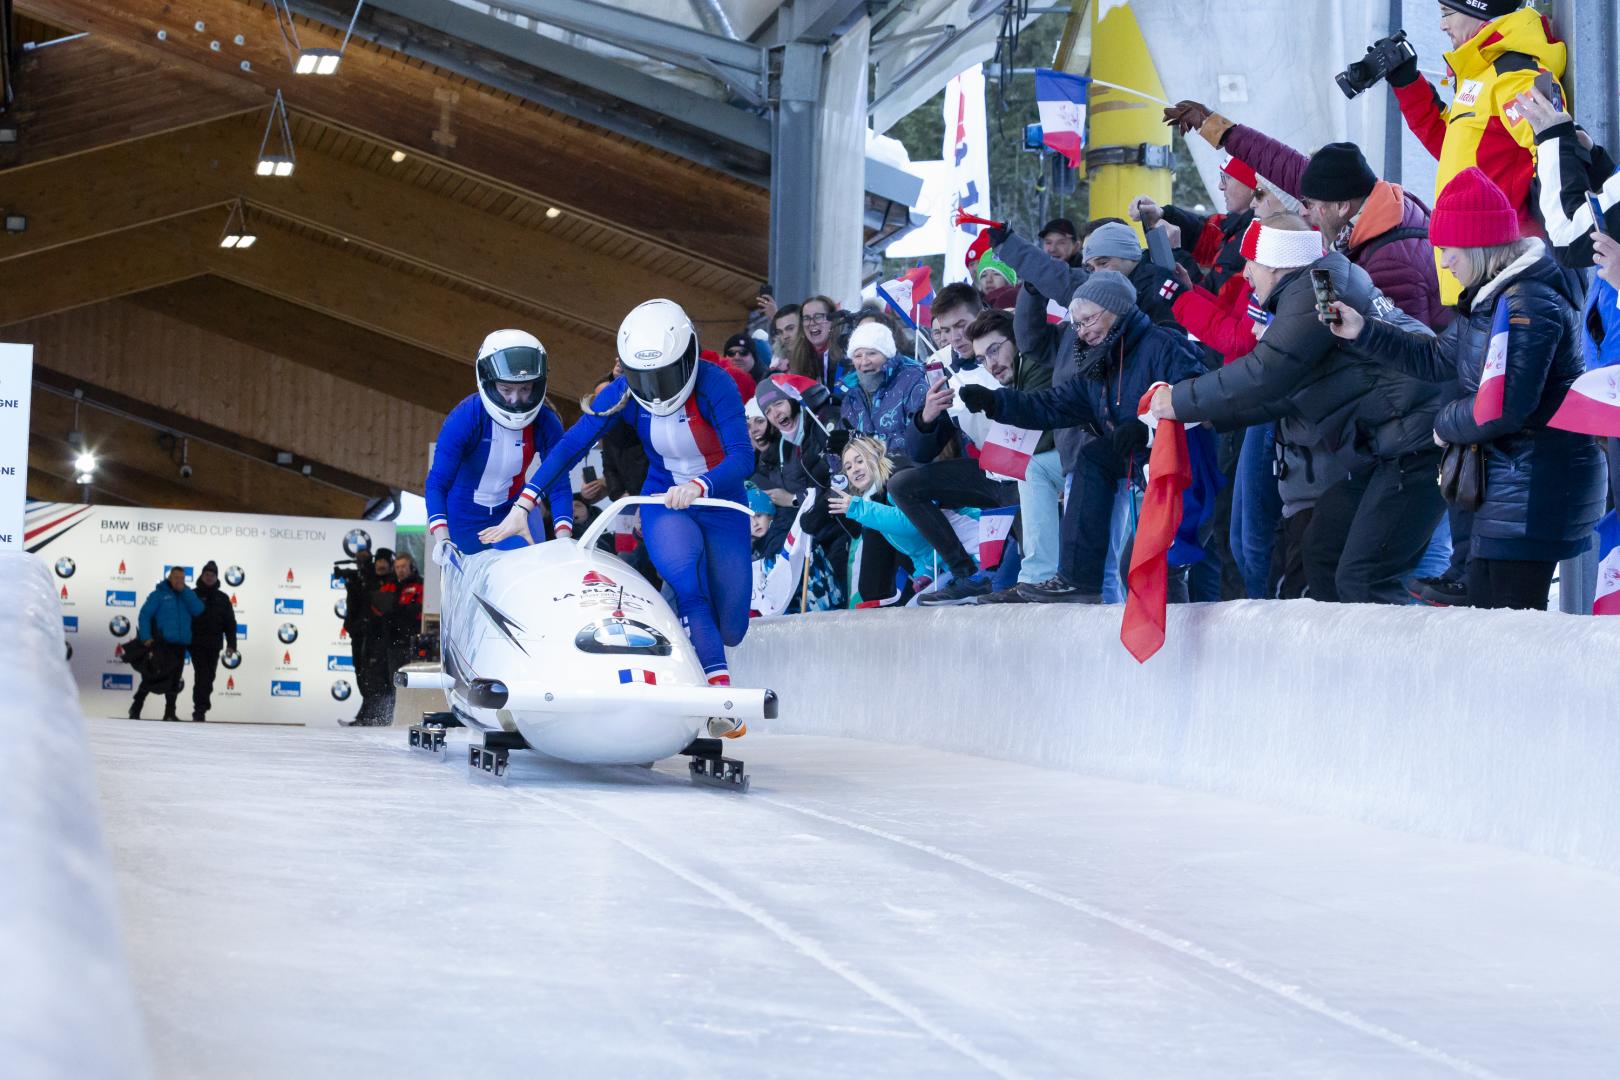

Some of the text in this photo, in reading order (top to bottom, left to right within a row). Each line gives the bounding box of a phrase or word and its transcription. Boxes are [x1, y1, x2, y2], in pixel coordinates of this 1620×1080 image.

[1466, 0, 1488, 11] SEIZ
[101, 520, 130, 530] BMW
[137, 522, 163, 532] IBSF
[167, 523, 207, 535] WORLD
[209, 525, 232, 537] CUP
[235, 527, 258, 537] BOB
[269, 527, 326, 541] SKELETON
[100, 534, 158, 546] LA PLAGNE
[553, 593, 576, 602] LA
